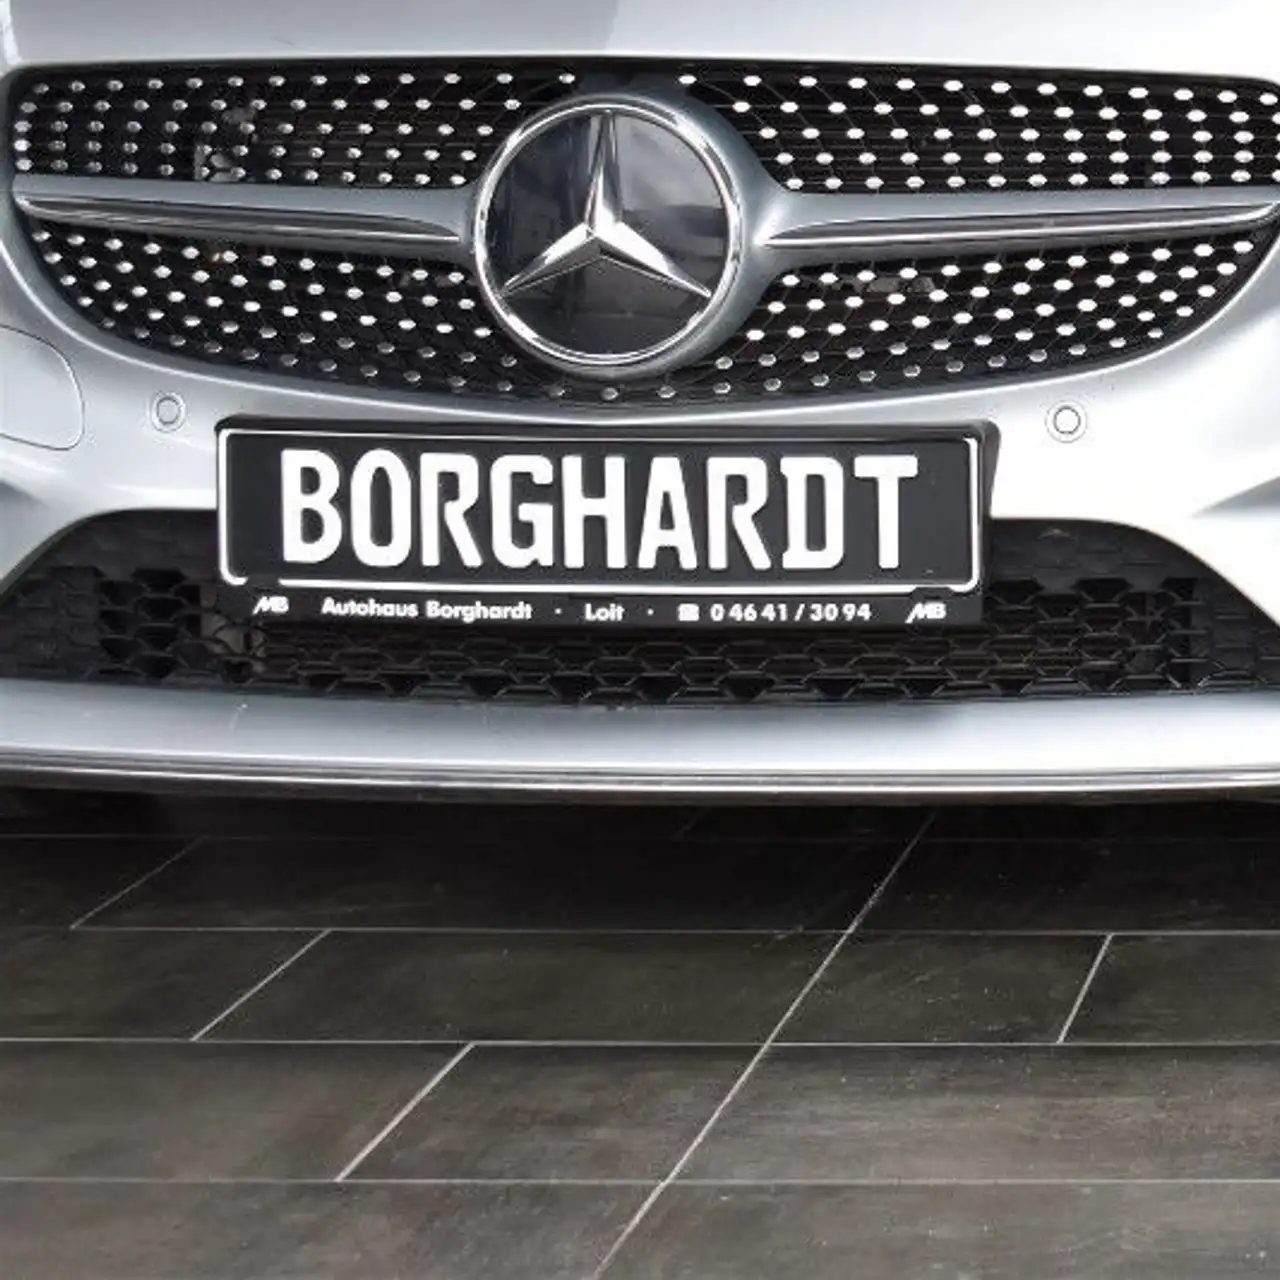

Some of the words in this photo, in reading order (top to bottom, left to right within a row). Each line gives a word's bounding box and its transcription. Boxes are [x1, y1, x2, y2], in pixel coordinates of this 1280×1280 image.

[280, 447, 919, 571] BORGHARDT
[321, 596, 419, 618] Autohaus
[425, 599, 534, 624] Borghardt
[584, 602, 626, 622] Loit
